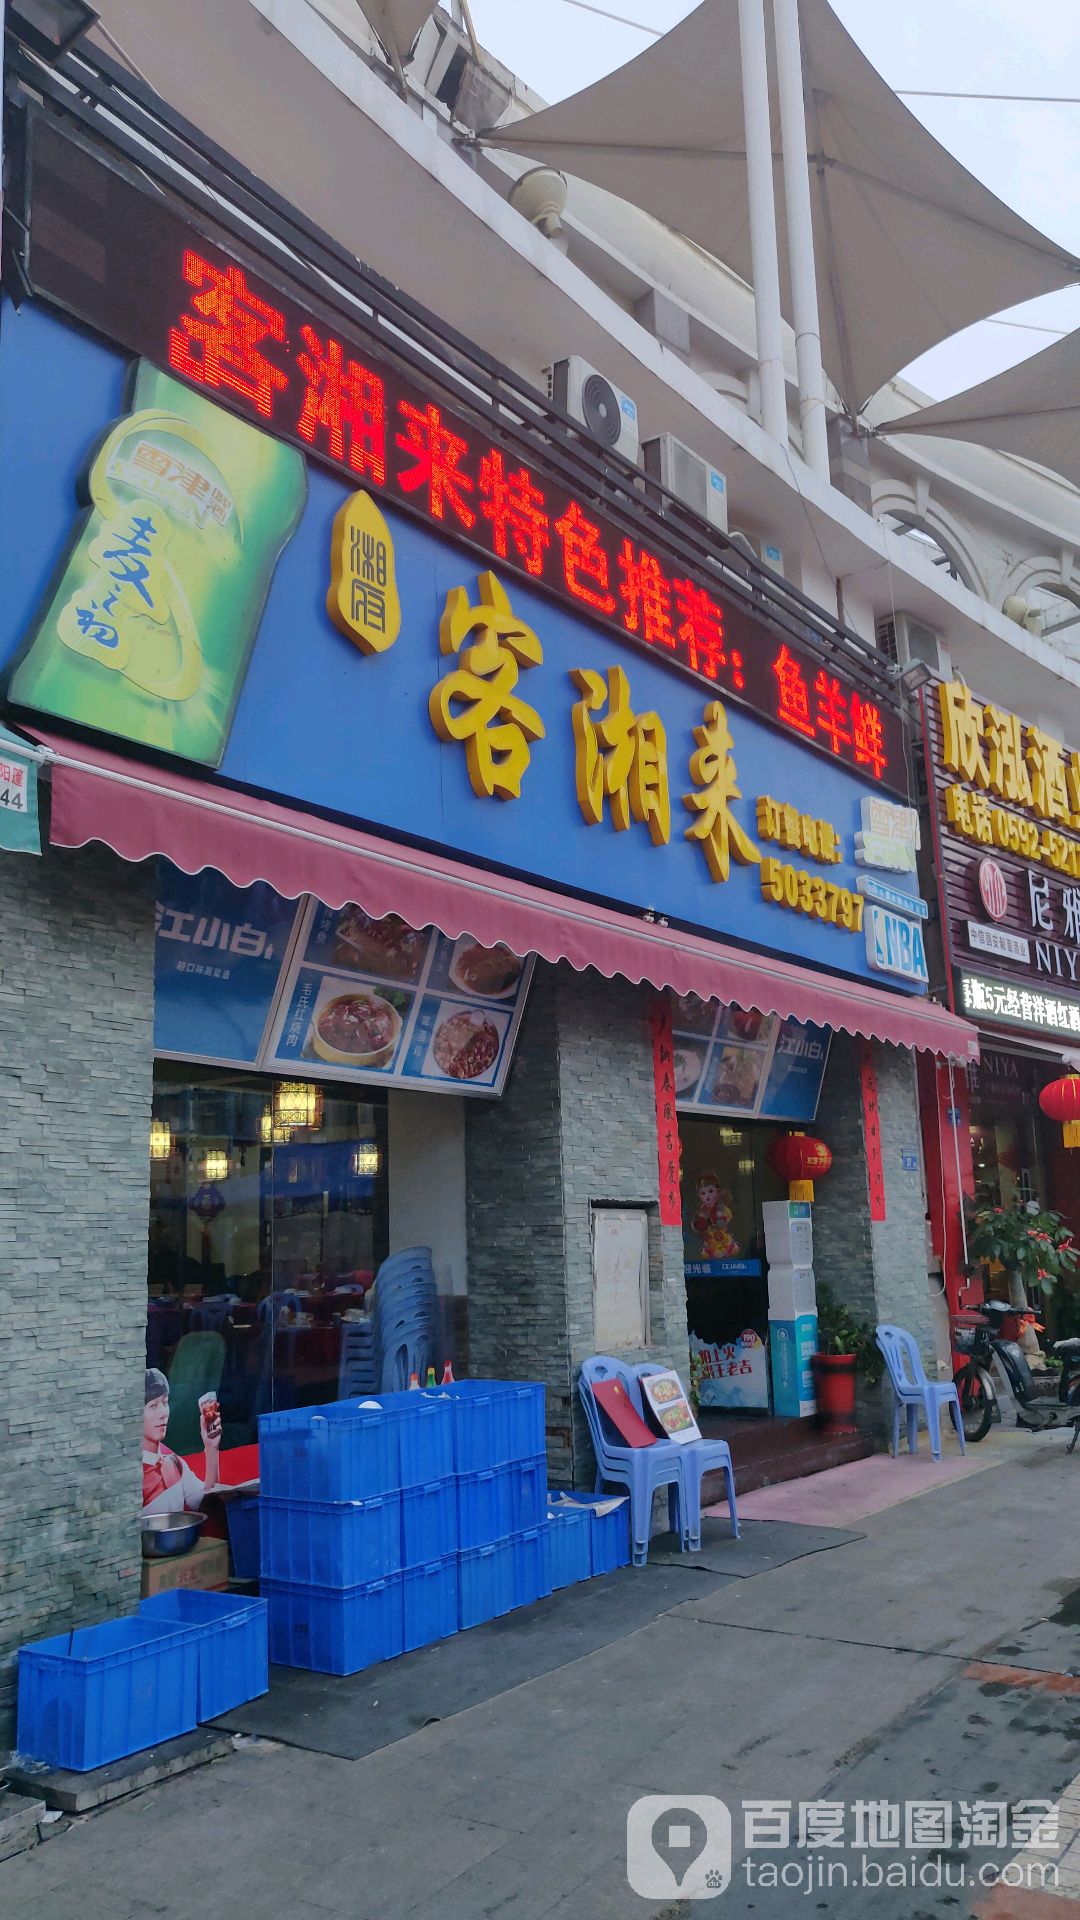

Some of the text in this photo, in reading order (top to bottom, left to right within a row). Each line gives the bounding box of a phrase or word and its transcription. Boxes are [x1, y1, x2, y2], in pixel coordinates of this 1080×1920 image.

[132, 441, 210, 501] 雪津
[429, 569, 762, 882] 客湘来
[945, 783, 993, 845] 电话
[760, 857, 864, 932] 5033797
[154, 901, 268, 957] 江小白
[884, 915, 927, 978] NBA
[778, 1035, 820, 1060] 江小白
